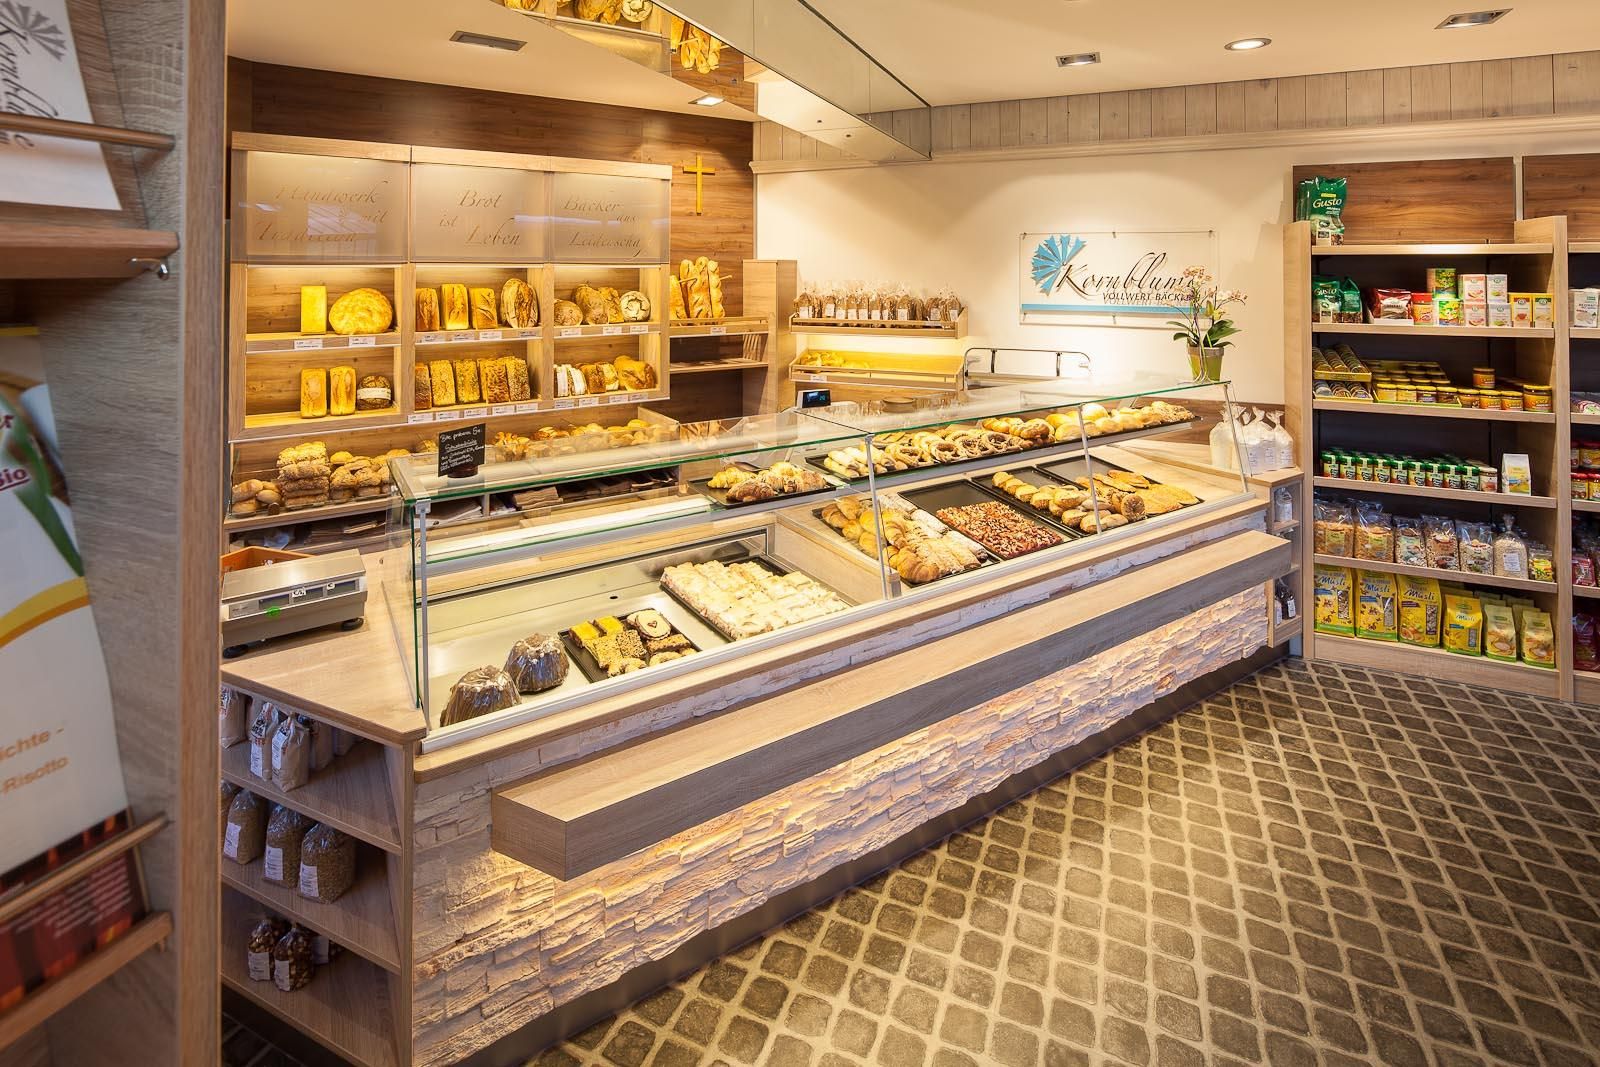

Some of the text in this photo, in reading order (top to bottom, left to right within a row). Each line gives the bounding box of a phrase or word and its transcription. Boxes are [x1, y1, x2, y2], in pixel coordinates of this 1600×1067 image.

[459, 189, 503, 208] Brot
[1312, 197, 1343, 209] Gusto
[439, 214, 458, 228] ist
[465, 217, 521, 247] Leben
[1319, 576, 1346, 586] Müsli
[1363, 583, 1391, 594] Müsli
[1402, 588, 1436, 601] Müsli
